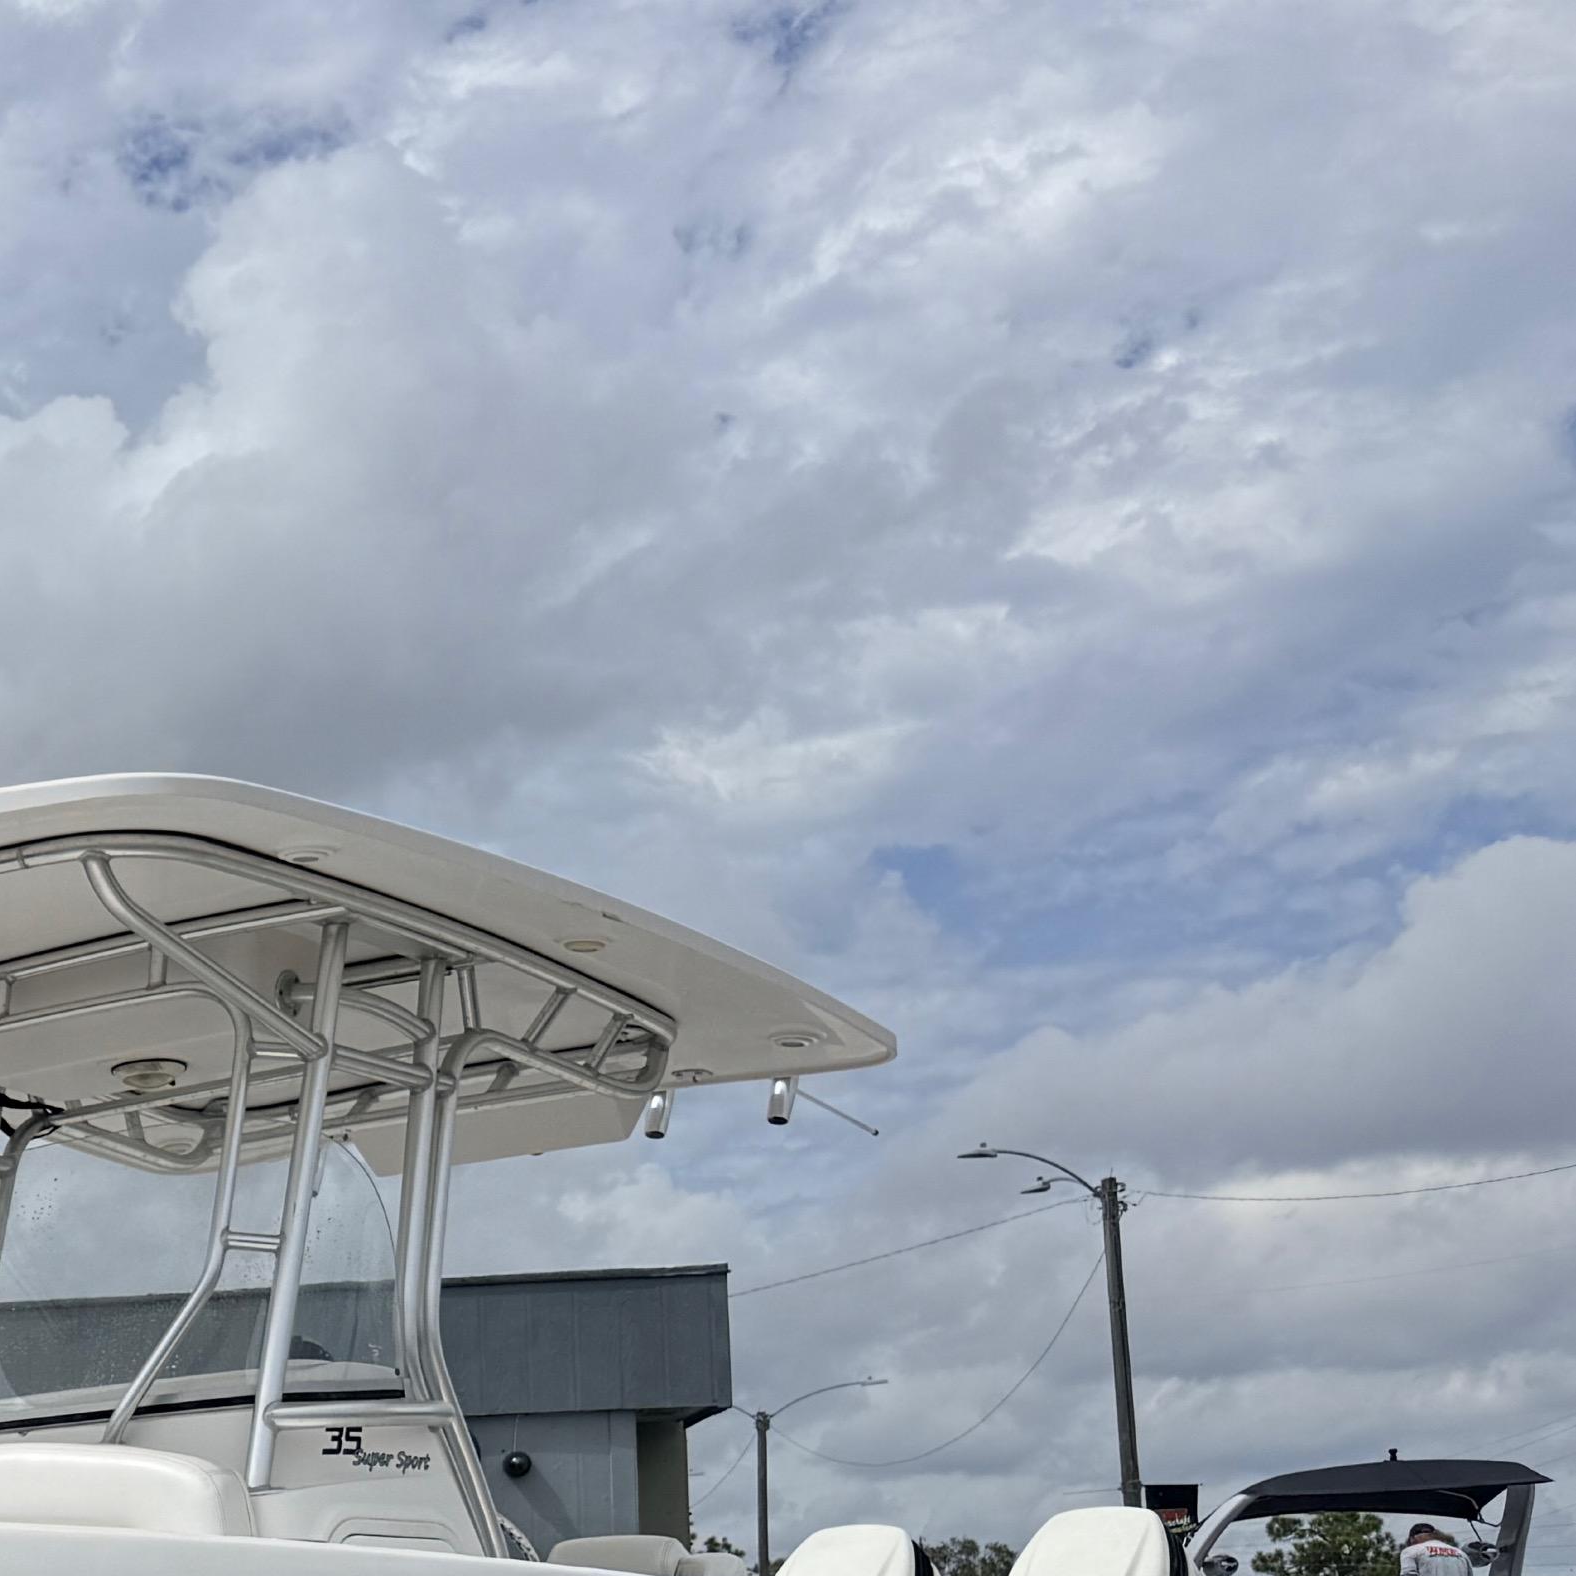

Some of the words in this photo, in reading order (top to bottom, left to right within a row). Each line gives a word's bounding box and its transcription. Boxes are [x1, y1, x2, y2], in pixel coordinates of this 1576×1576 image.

[322, 1426, 362, 1455] 35
[352, 1448, 394, 1472] Super
[396, 1451, 431, 1475] Sport
